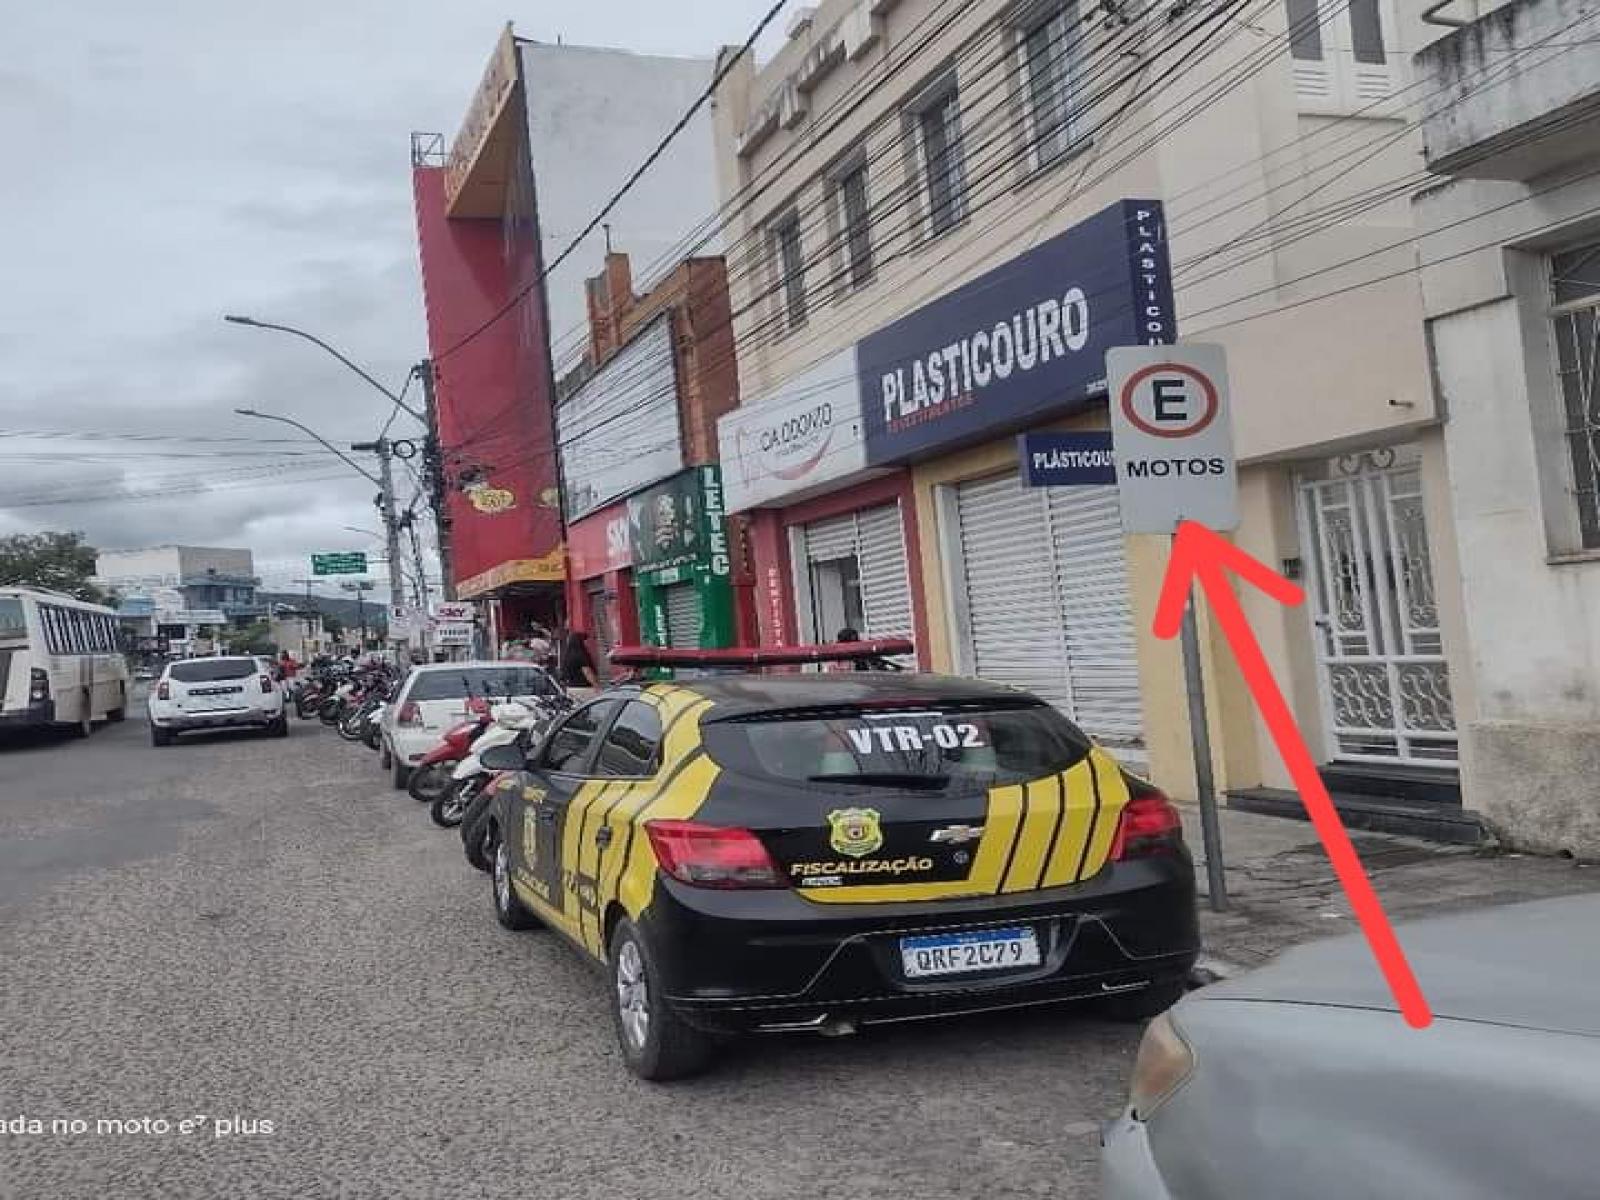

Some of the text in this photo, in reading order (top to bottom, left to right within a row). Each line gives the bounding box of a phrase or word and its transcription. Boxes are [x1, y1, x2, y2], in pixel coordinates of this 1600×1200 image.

[1136, 208, 1163, 345] PLASTICOU
[881, 287, 1089, 422] PLASTICOURO
[1152, 379, 1188, 421] E
[1126, 457, 1226, 479] MOTOS
[847, 724, 984, 754] VTR-02
[789, 855, 934, 876] FISCALIZAÇÃO
[916, 940, 1024, 972] QRF2C79
